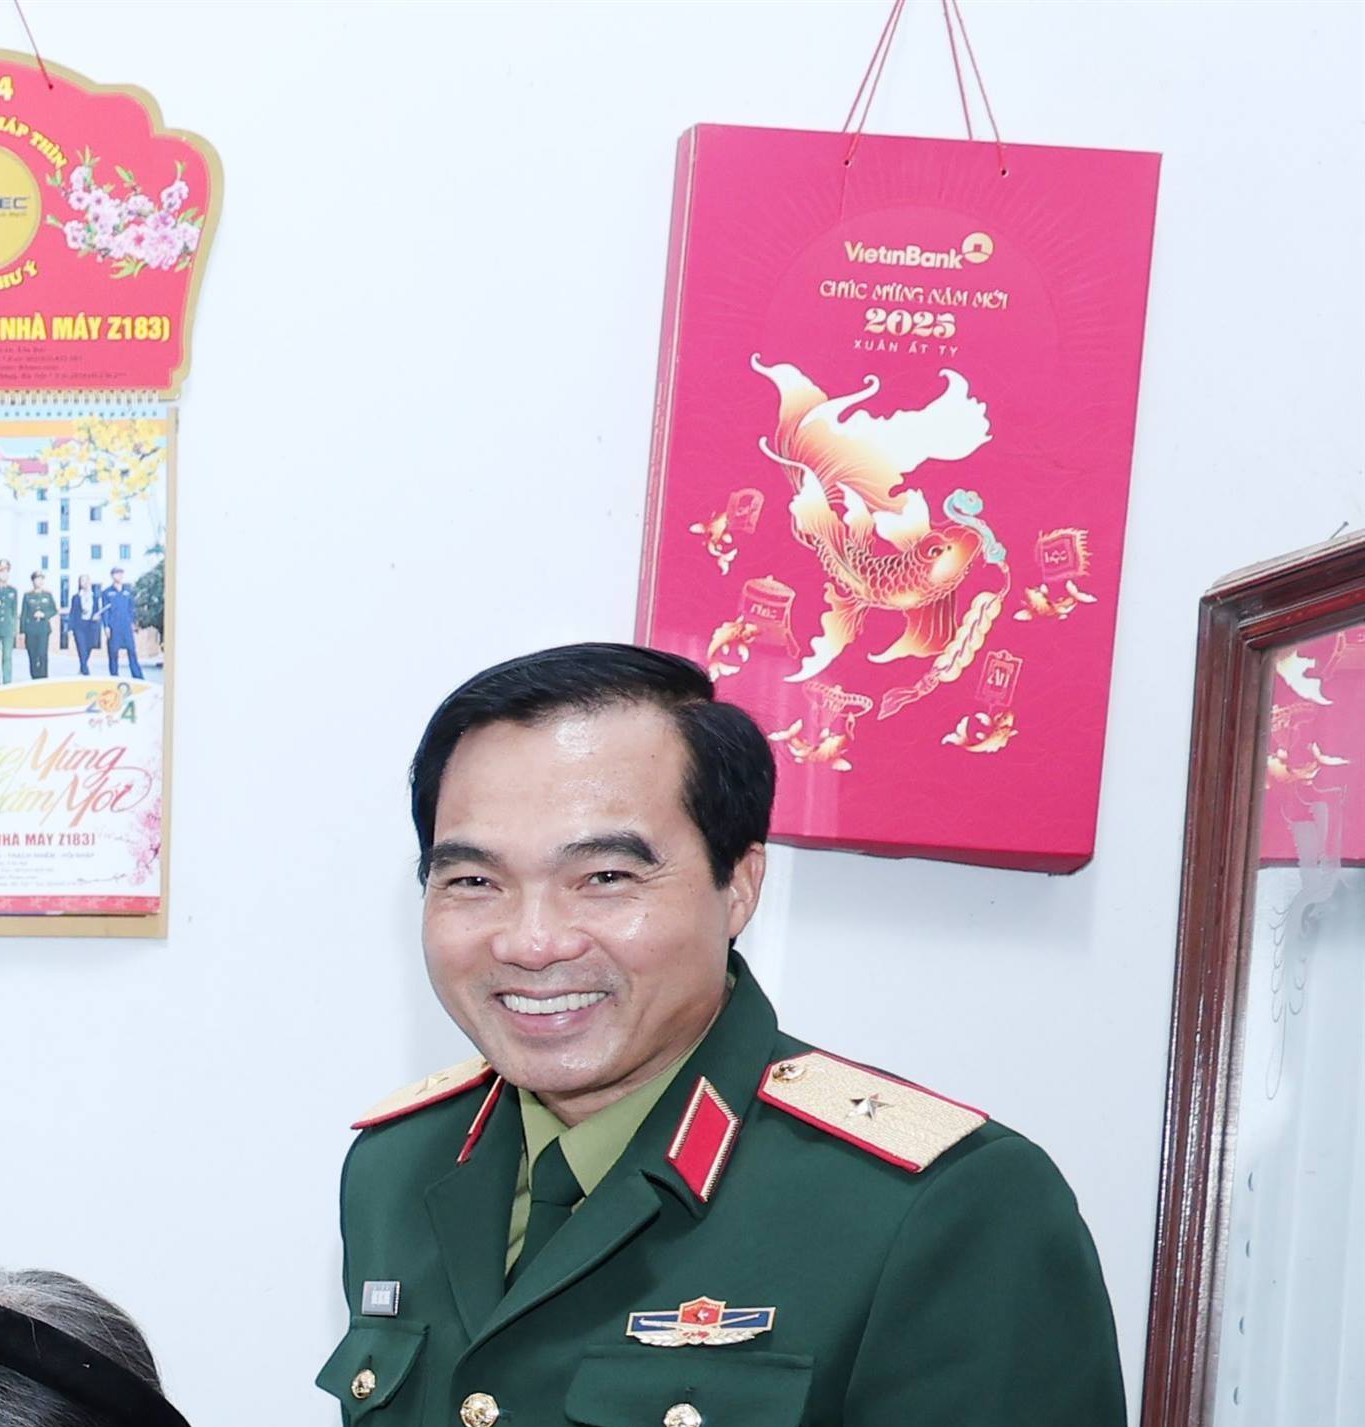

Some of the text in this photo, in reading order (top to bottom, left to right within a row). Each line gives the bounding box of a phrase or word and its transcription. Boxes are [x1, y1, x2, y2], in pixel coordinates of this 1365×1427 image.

[844, 240, 964, 270] VietinBank
[52, 311, 103, 342] MÁY
[106, 315, 171, 343] Z183)
[863, 306, 957, 340] 2025
[853, 338, 899, 354] XUÂN
